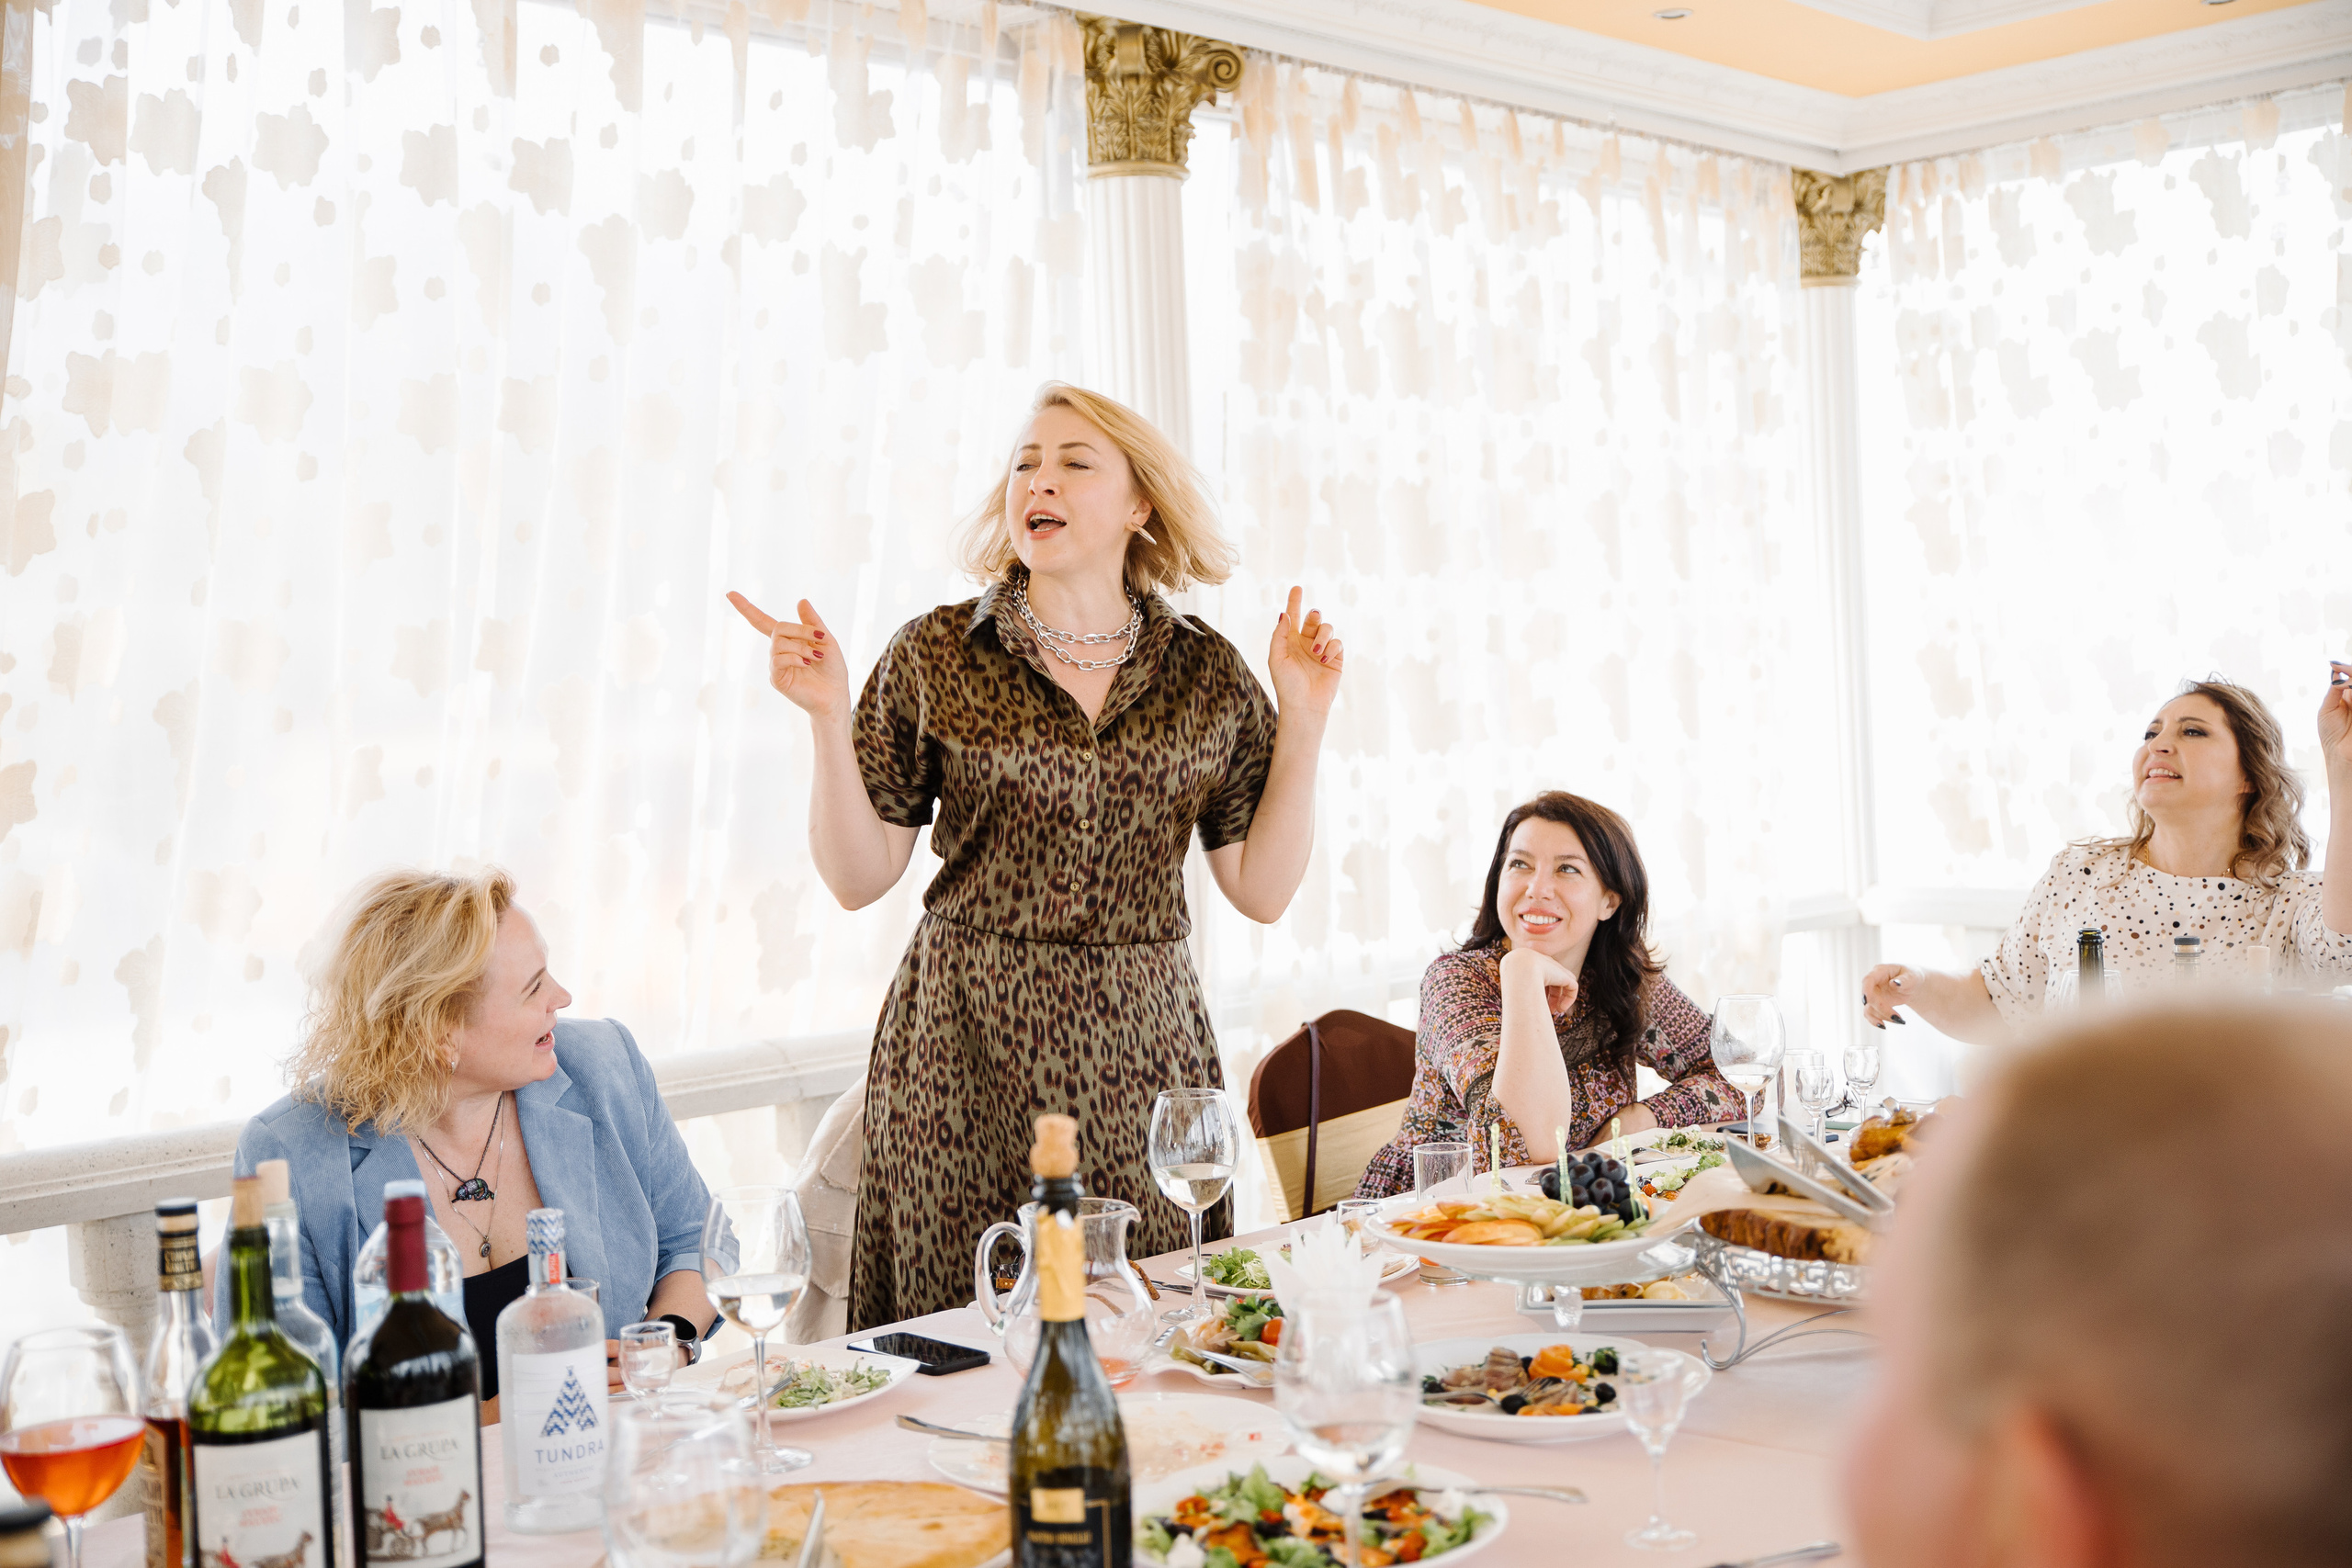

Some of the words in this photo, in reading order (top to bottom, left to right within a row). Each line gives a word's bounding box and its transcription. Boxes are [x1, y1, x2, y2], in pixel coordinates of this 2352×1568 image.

[379, 1445, 401, 1461] LA
[403, 1438, 459, 1461] GRUPA
[534, 1438, 605, 1464] TUNDRA
[214, 1483, 236, 1500] LA
[239, 1475, 301, 1502] GRUPA
